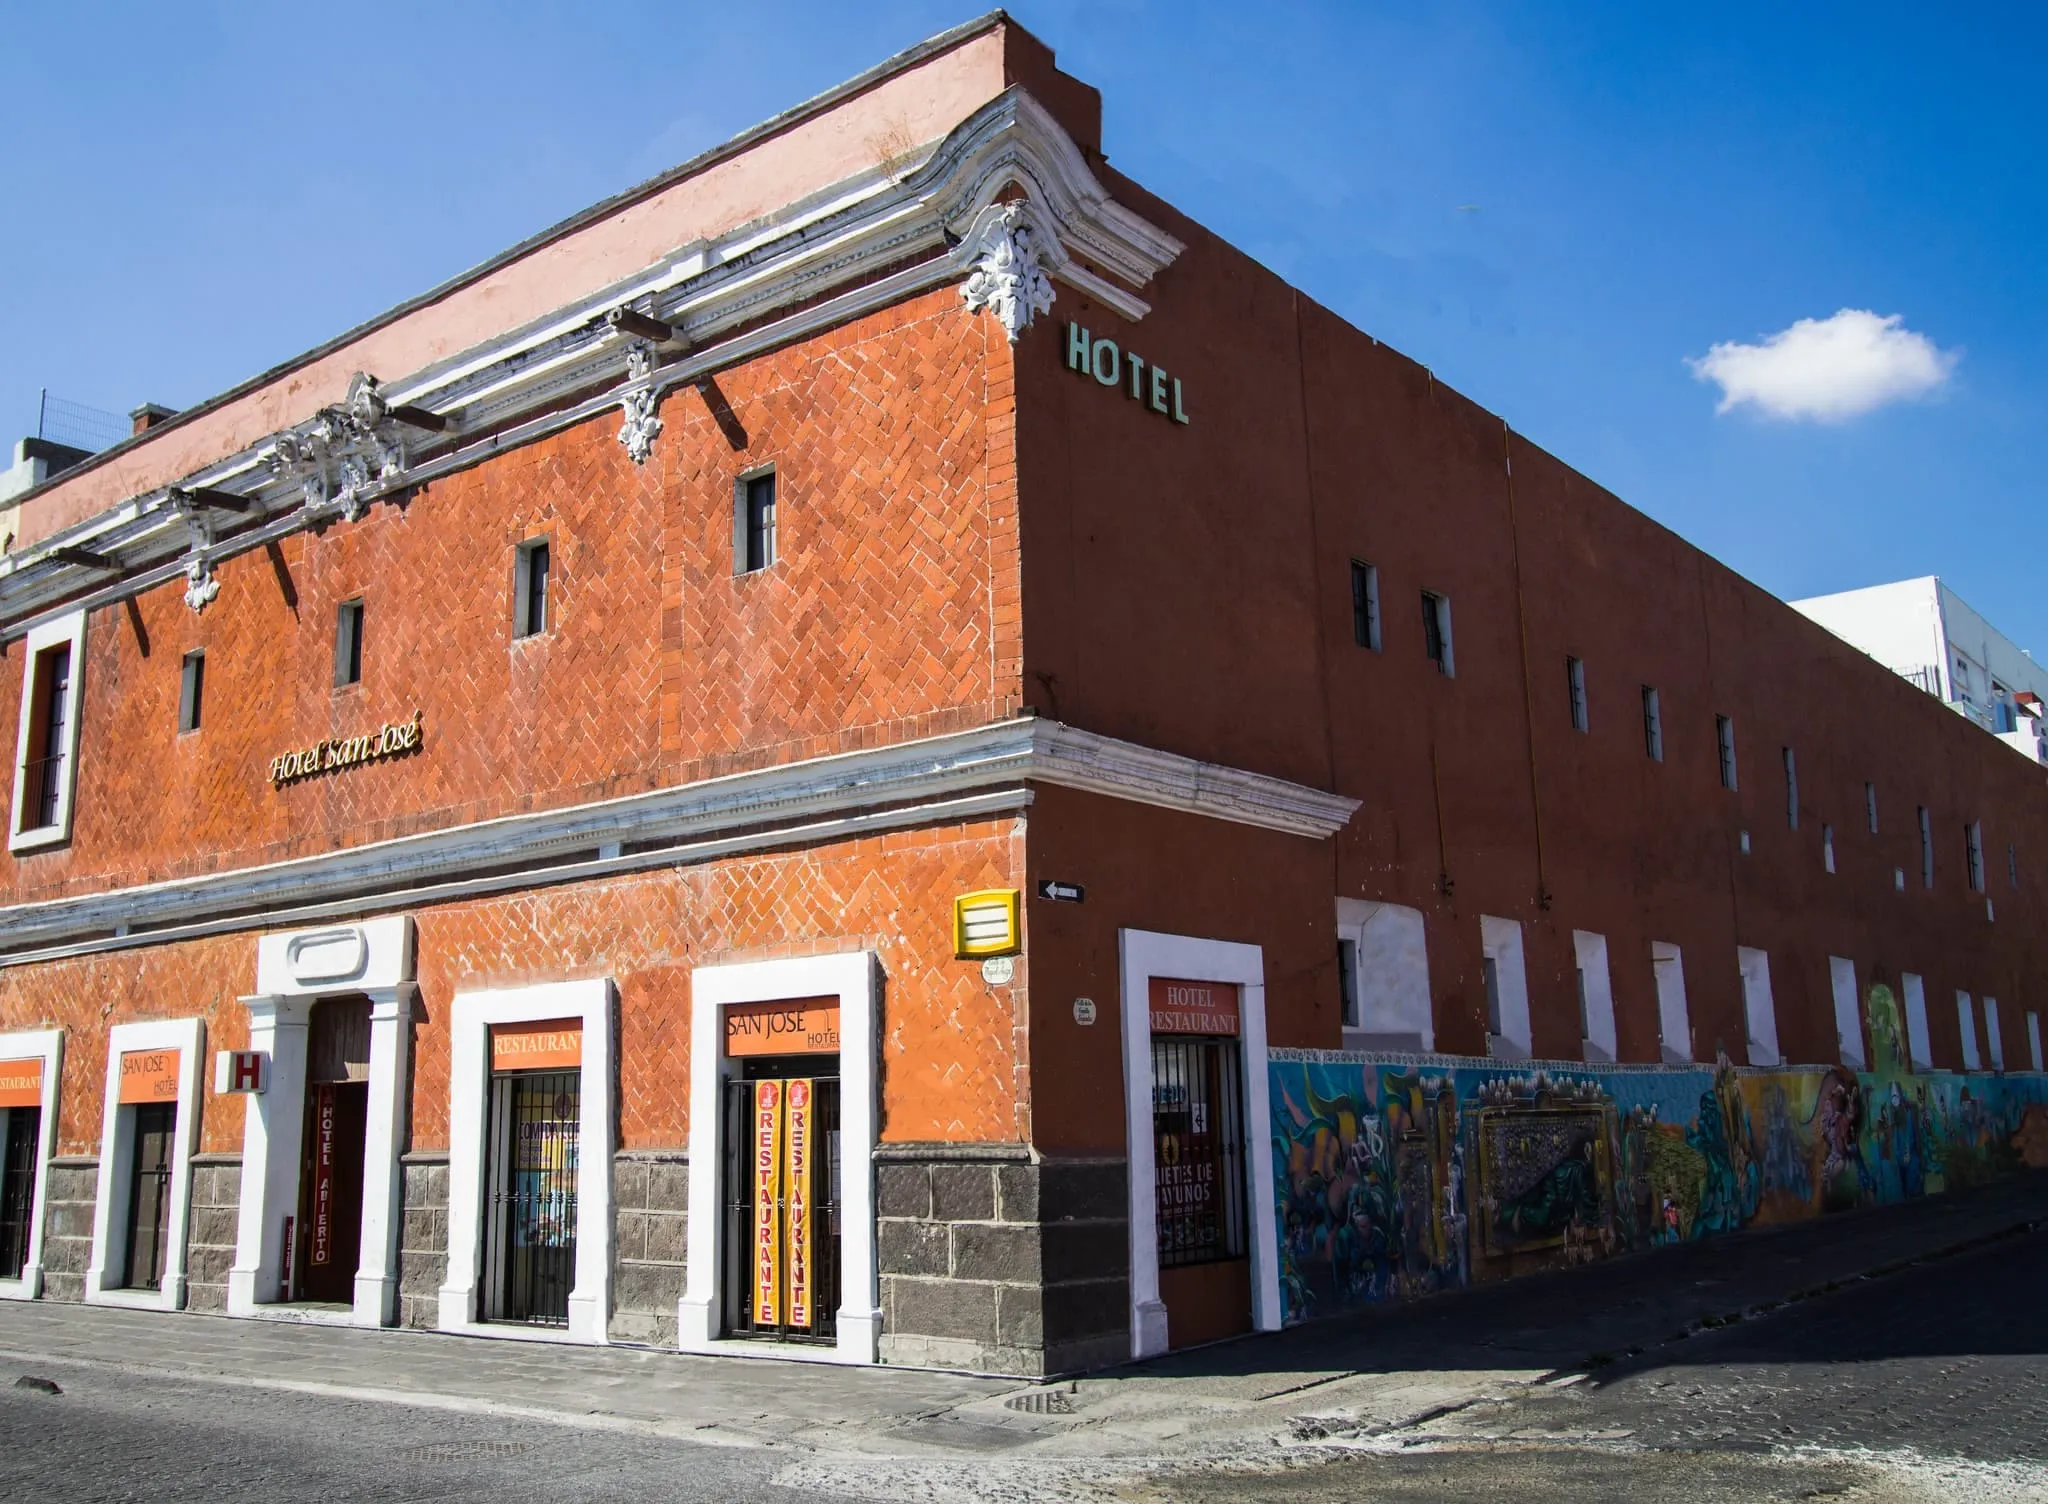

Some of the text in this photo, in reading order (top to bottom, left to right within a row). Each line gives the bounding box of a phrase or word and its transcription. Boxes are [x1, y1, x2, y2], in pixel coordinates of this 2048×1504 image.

[1068, 321, 1189, 425] HOTEL
[266, 709, 423, 783] Hotel San José
[1167, 986, 1216, 1008] HOTEL
[728, 1004, 807, 1039] SAN JOSÉ
[807, 1032, 840, 1044] HOTEL
[1149, 1011, 1238, 1033] RESTAURANT
[123, 1057, 141, 1075] SAN
[235, 1054, 260, 1089] H
[154, 1080, 178, 1091] HOTEL
[315, 1107, 334, 1262] HOTEL ABIERTO
[1196, 1162, 1213, 1181] DE
[759, 1112, 774, 1322] RESTAURANTE
[790, 1111, 805, 1323] RESTAURANTE
